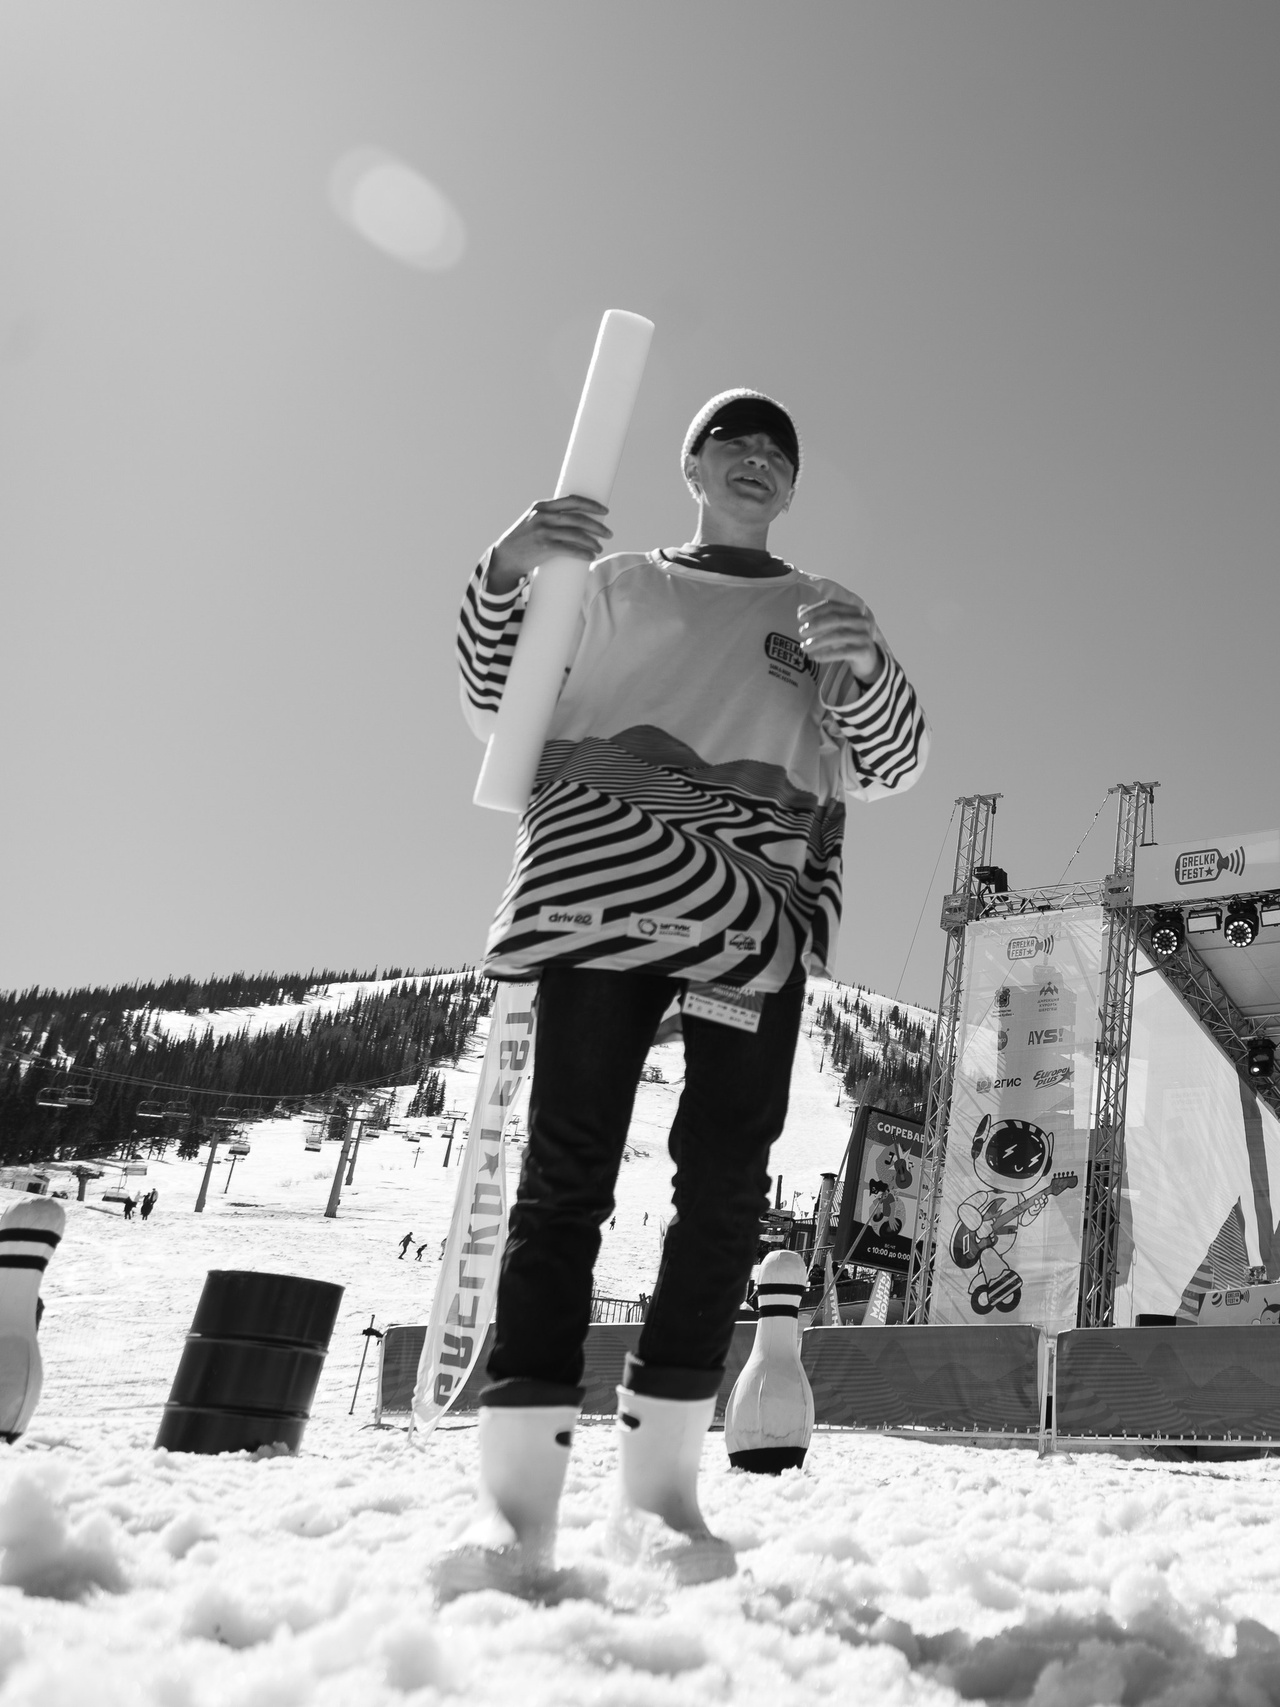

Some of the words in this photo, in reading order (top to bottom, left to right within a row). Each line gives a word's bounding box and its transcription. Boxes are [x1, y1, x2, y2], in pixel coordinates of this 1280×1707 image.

[771, 647, 793, 663] FEST
[1182, 853, 1216, 868] GRELKA
[1181, 867, 1204, 880] FEST
[1012, 940, 1035, 949] GRELKA
[1011, 949, 1026, 957] FEST
[1027, 1028, 1064, 1045] AYS!
[994, 1078, 1021, 1088] 2ГИС
[877, 1122, 925, 1143] СОГРЕВАЕ
[872, 1247, 888, 1256] 10:00
[897, 1252, 911, 1261] 0:00
